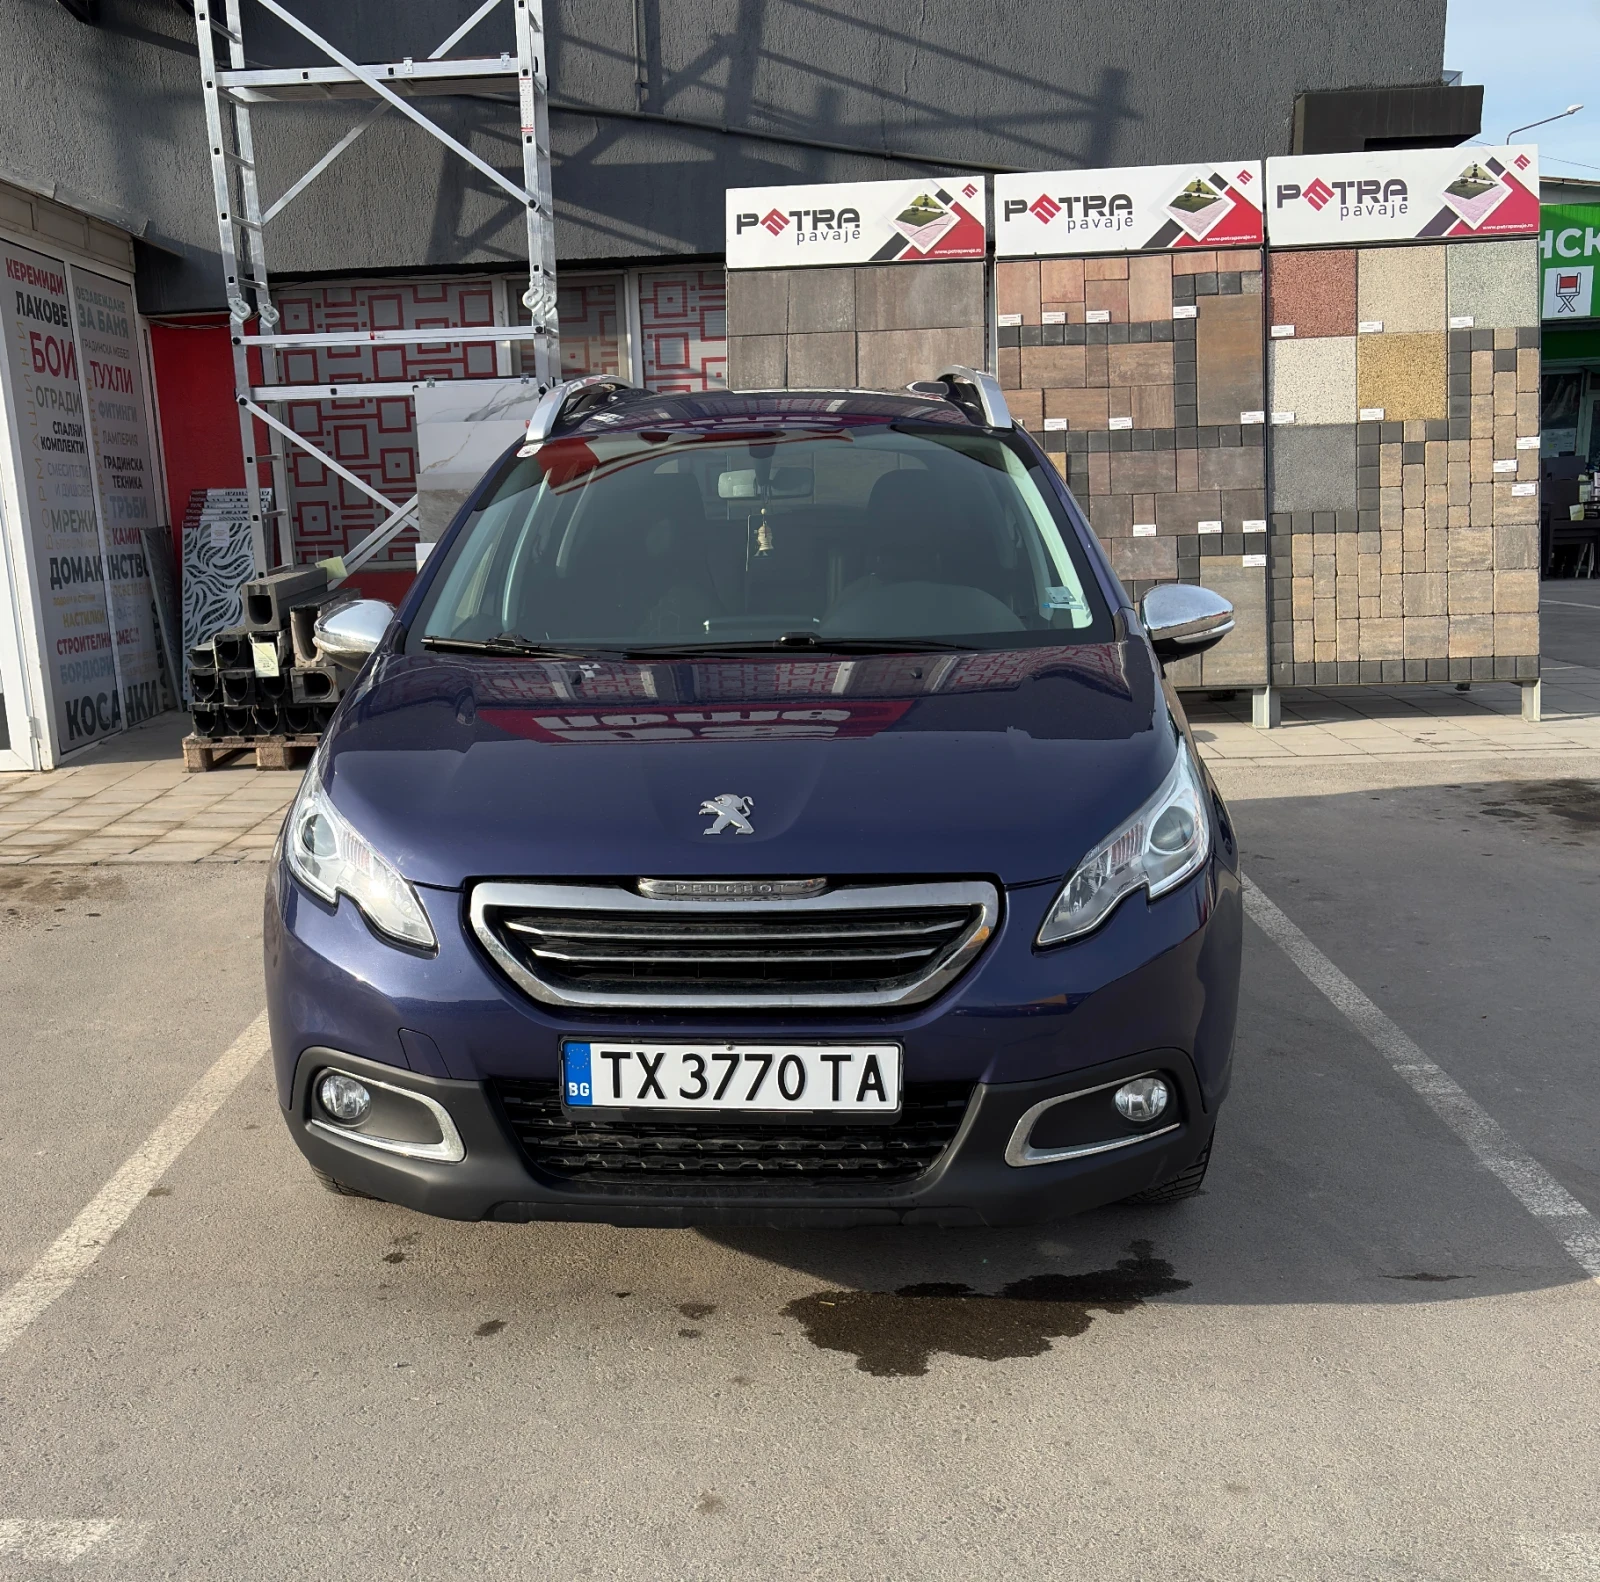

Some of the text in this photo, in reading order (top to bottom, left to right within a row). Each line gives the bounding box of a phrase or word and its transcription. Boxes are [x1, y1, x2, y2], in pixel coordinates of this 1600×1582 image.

[1276, 177, 1409, 212] PETRA
[1003, 193, 1133, 225] PETRA
[1340, 200, 1409, 221] pavaje
[736, 207, 861, 237] PETRA
[1067, 213, 1134, 234] pavaje
[796, 228, 861, 246] pavaje
[5, 256, 65, 297] КЕРЕМИДИ
[15, 290, 69, 327] ЛАКОВЕ
[78, 303, 129, 339] ЗА БАНЯ
[29, 330, 77, 381] БОИ
[89, 360, 134, 395] ТУХЛИ
[35, 385, 82, 417] ОГРАДИ
[98, 400, 138, 423] ФИТИНГИ
[52, 420, 84, 438] СПАЛНИ
[102, 429, 139, 448] ЛАМПЕРИЯ
[40, 435, 86, 454] КОМПЛЕКТИ
[103, 454, 144, 473] ГРАДИНСКА
[111, 475, 144, 490] ТЕХНИКА
[109, 495, 149, 519] ТРЪБИ
[50, 509, 98, 533] МРЕЖИ
[62, 608, 106, 629] НАСТИЛКИ
[59, 655, 114, 685] БОРДЮРИ
[600, 1051, 888, 1103] TX 3770 TA
[568, 1082, 590, 1097] BG
